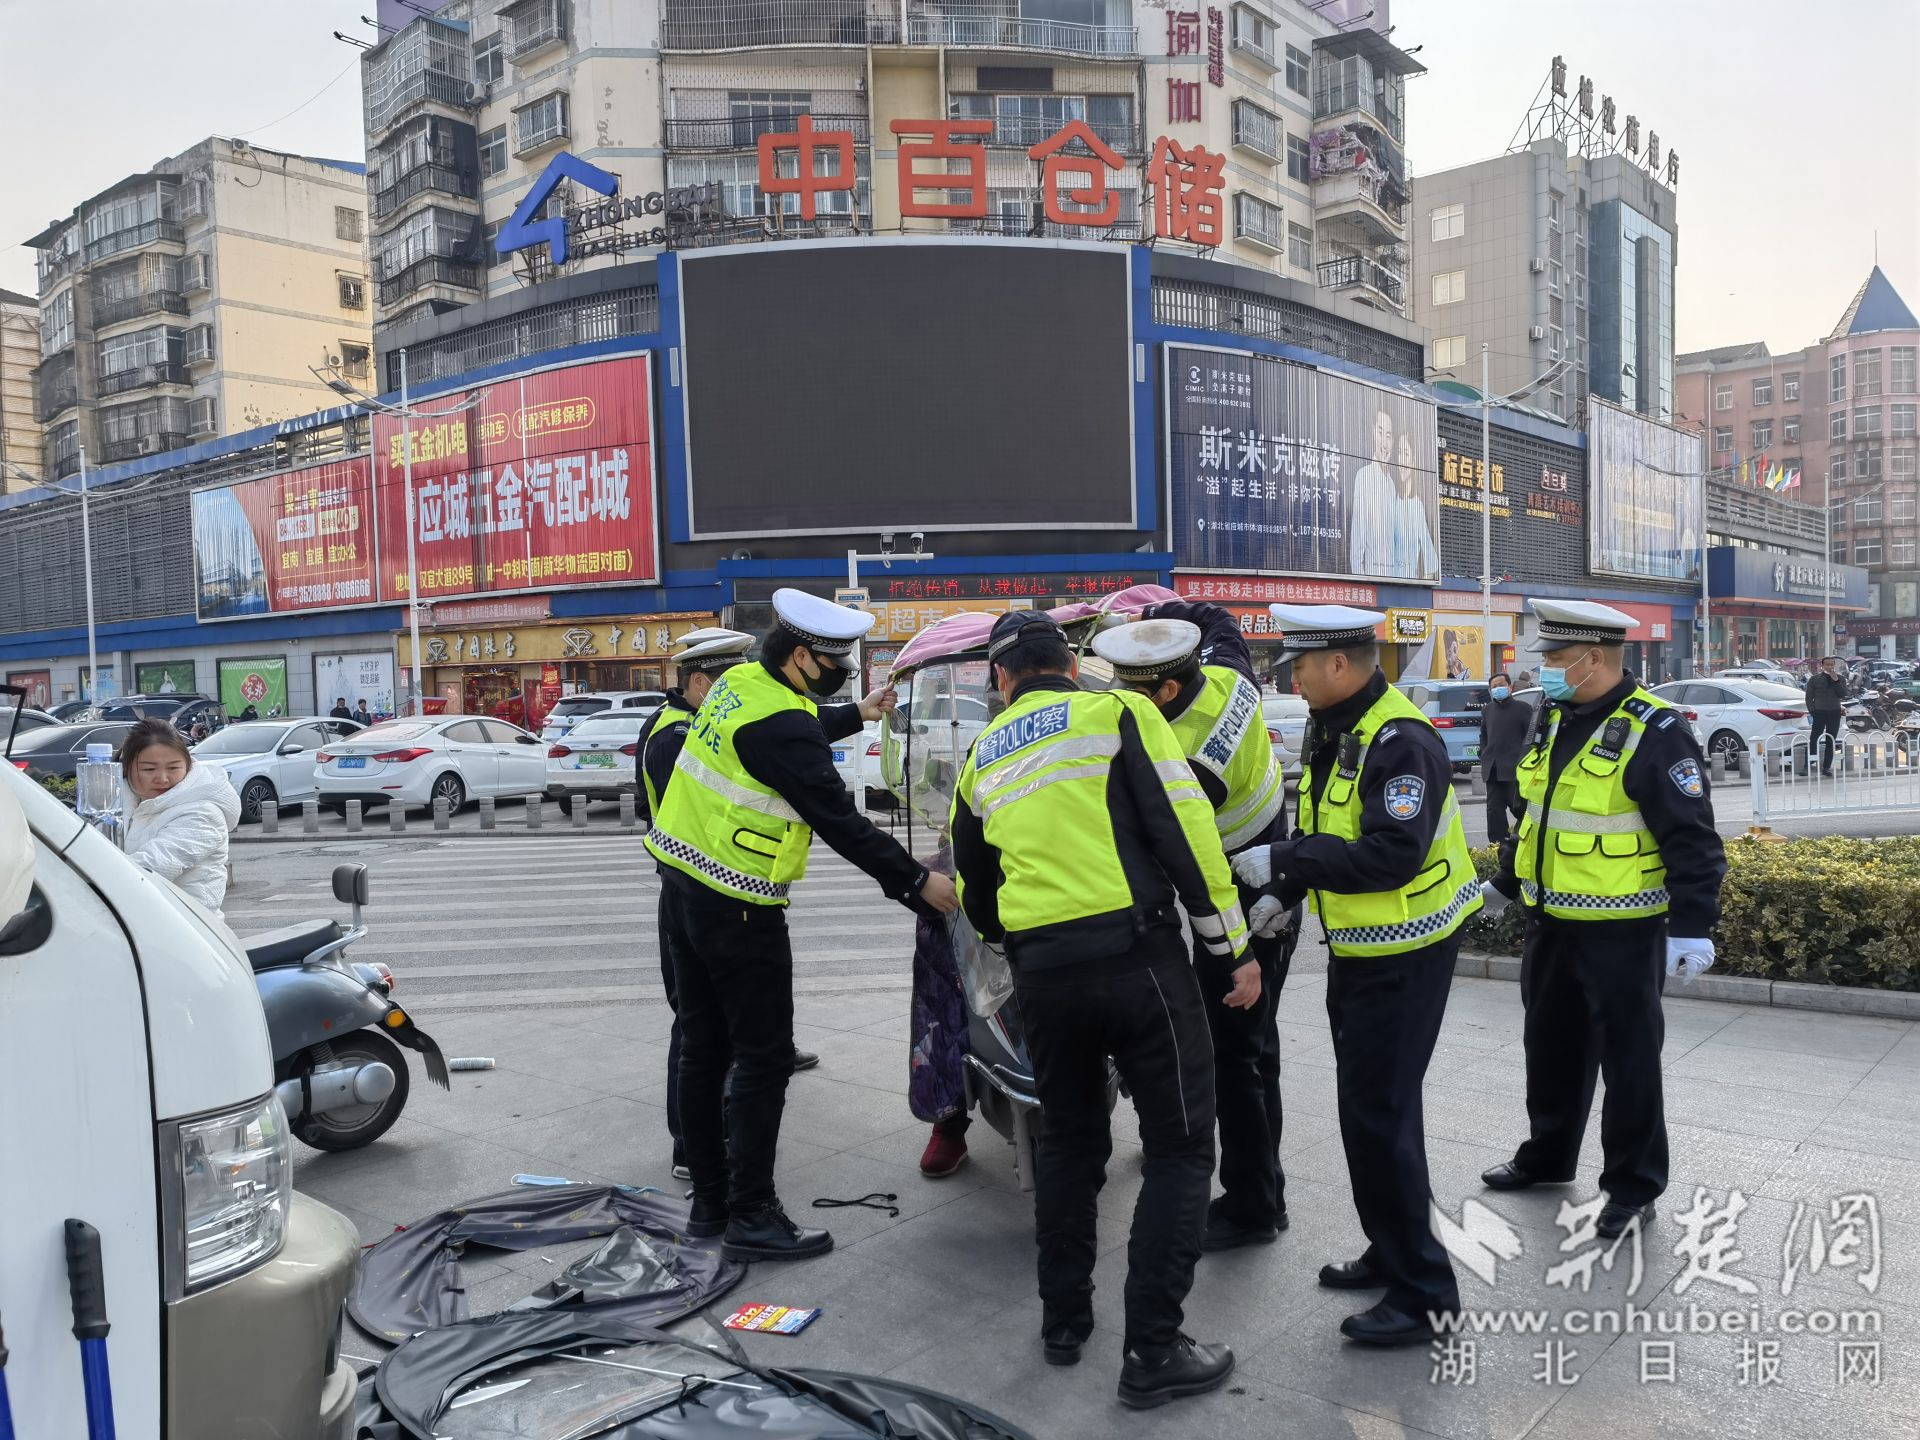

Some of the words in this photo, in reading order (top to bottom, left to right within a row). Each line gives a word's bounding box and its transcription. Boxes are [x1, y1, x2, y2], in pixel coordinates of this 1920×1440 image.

[759, 115, 1226, 246] 中百仓储
[1185, 385, 1205, 393] CIMIC
[1198, 425, 1341, 483] 斯米克磁砖
[1443, 451, 1504, 493] 标点装饰
[418, 448, 631, 545] 应城五金汽配城
[282, 551, 299, 569] 宜商
[306, 547, 324, 566] 宜居
[328, 542, 357, 563] 宜办公
[1188, 580, 1373, 604] 坚定不移走中国特色社会主义政治发展道路
[454, 632, 516, 662] 中国珠宝
